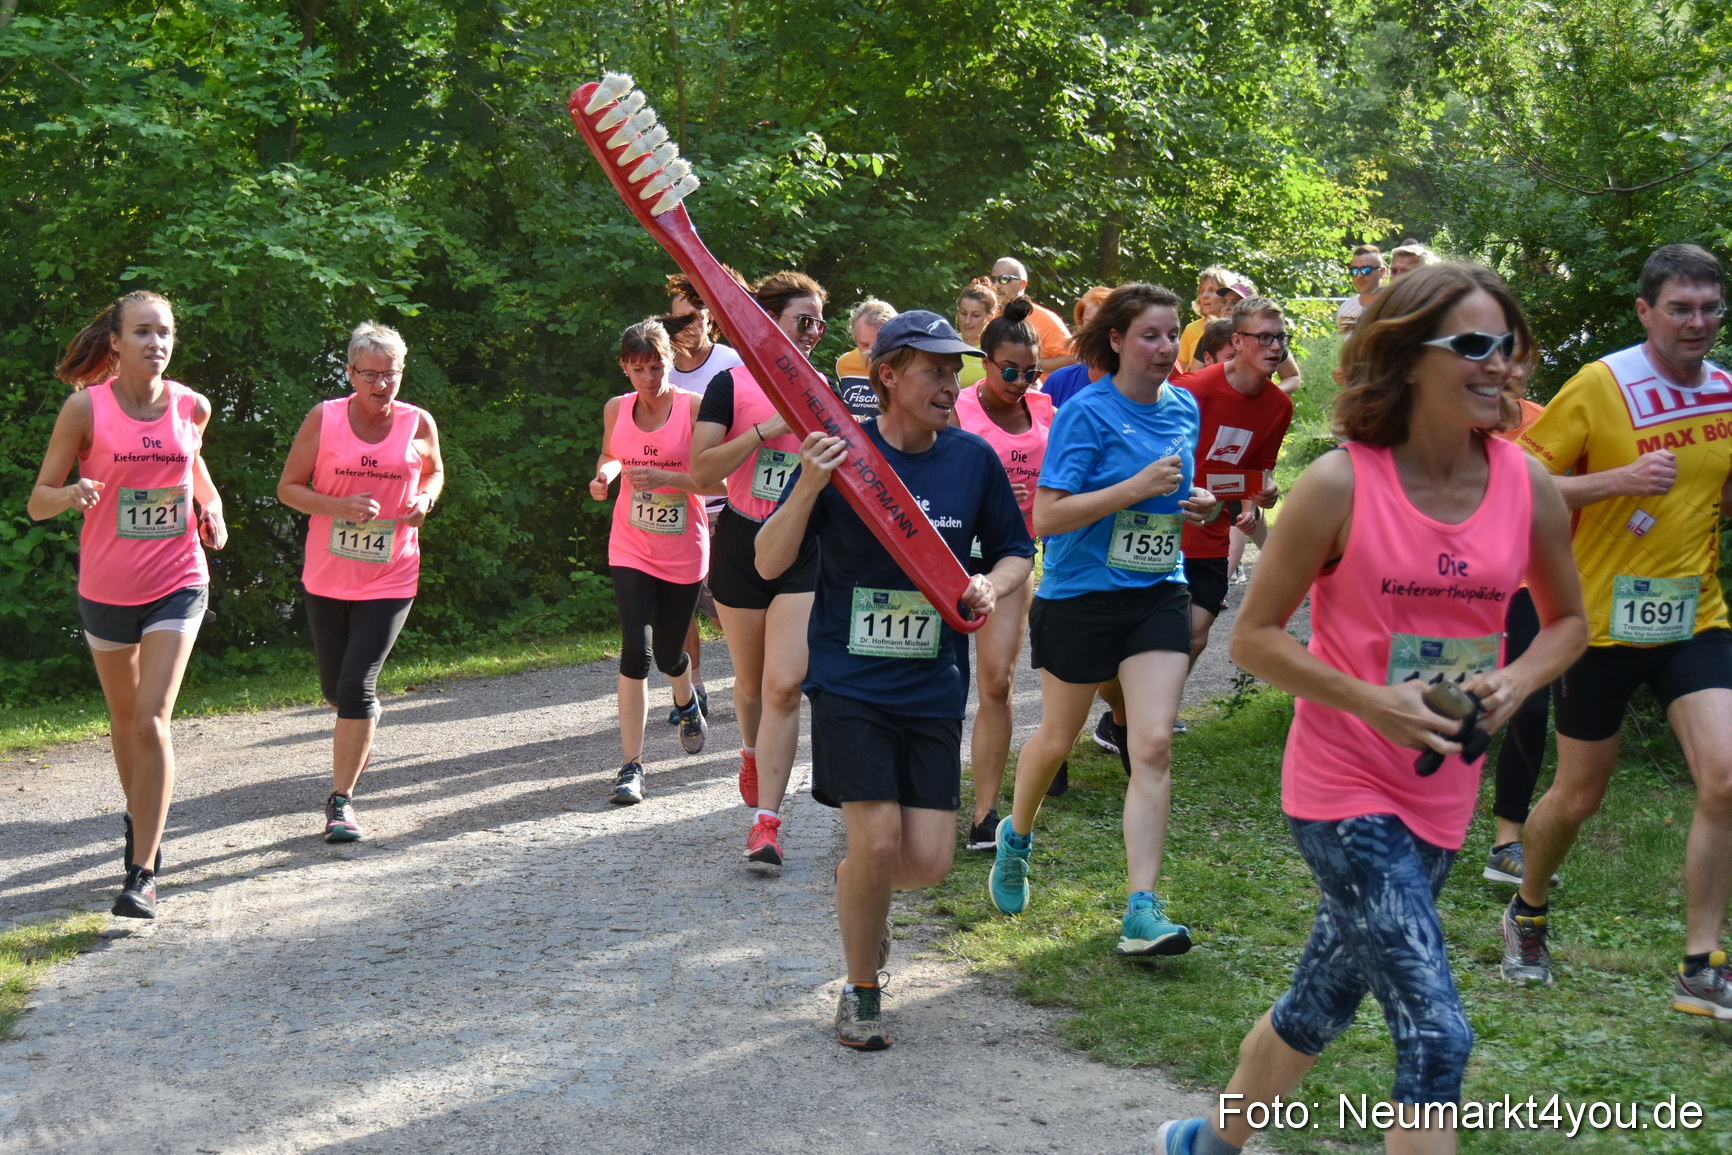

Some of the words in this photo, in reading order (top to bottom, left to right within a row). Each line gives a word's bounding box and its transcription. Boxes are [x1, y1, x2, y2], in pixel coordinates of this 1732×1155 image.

[849, 392, 880, 403] Fisch
[142, 436, 163, 449] Die
[643, 445, 658, 456] Die
[775, 355, 799, 384] DR.
[852, 457, 919, 539] HOFMANN
[1636, 427, 1696, 457] MAX
[361, 455, 378, 468] Die
[622, 458, 682, 469] Kieferorthopäden
[1011, 450, 1027, 463] Die
[335, 467, 402, 481] Kieferorthopäden
[763, 467, 793, 488] 11
[636, 503, 679, 523] 1123
[916, 495, 930, 511] ie
[127, 504, 178, 526] 1121
[338, 530, 385, 551] 1114
[1123, 531, 1175, 556] 1535
[1438, 553, 1468, 577] Die
[1624, 600, 1685, 625] 1691
[863, 612, 930, 640] 1117
[872, 638, 903, 646] Hofmann
[905, 639, 930, 647] Michael
